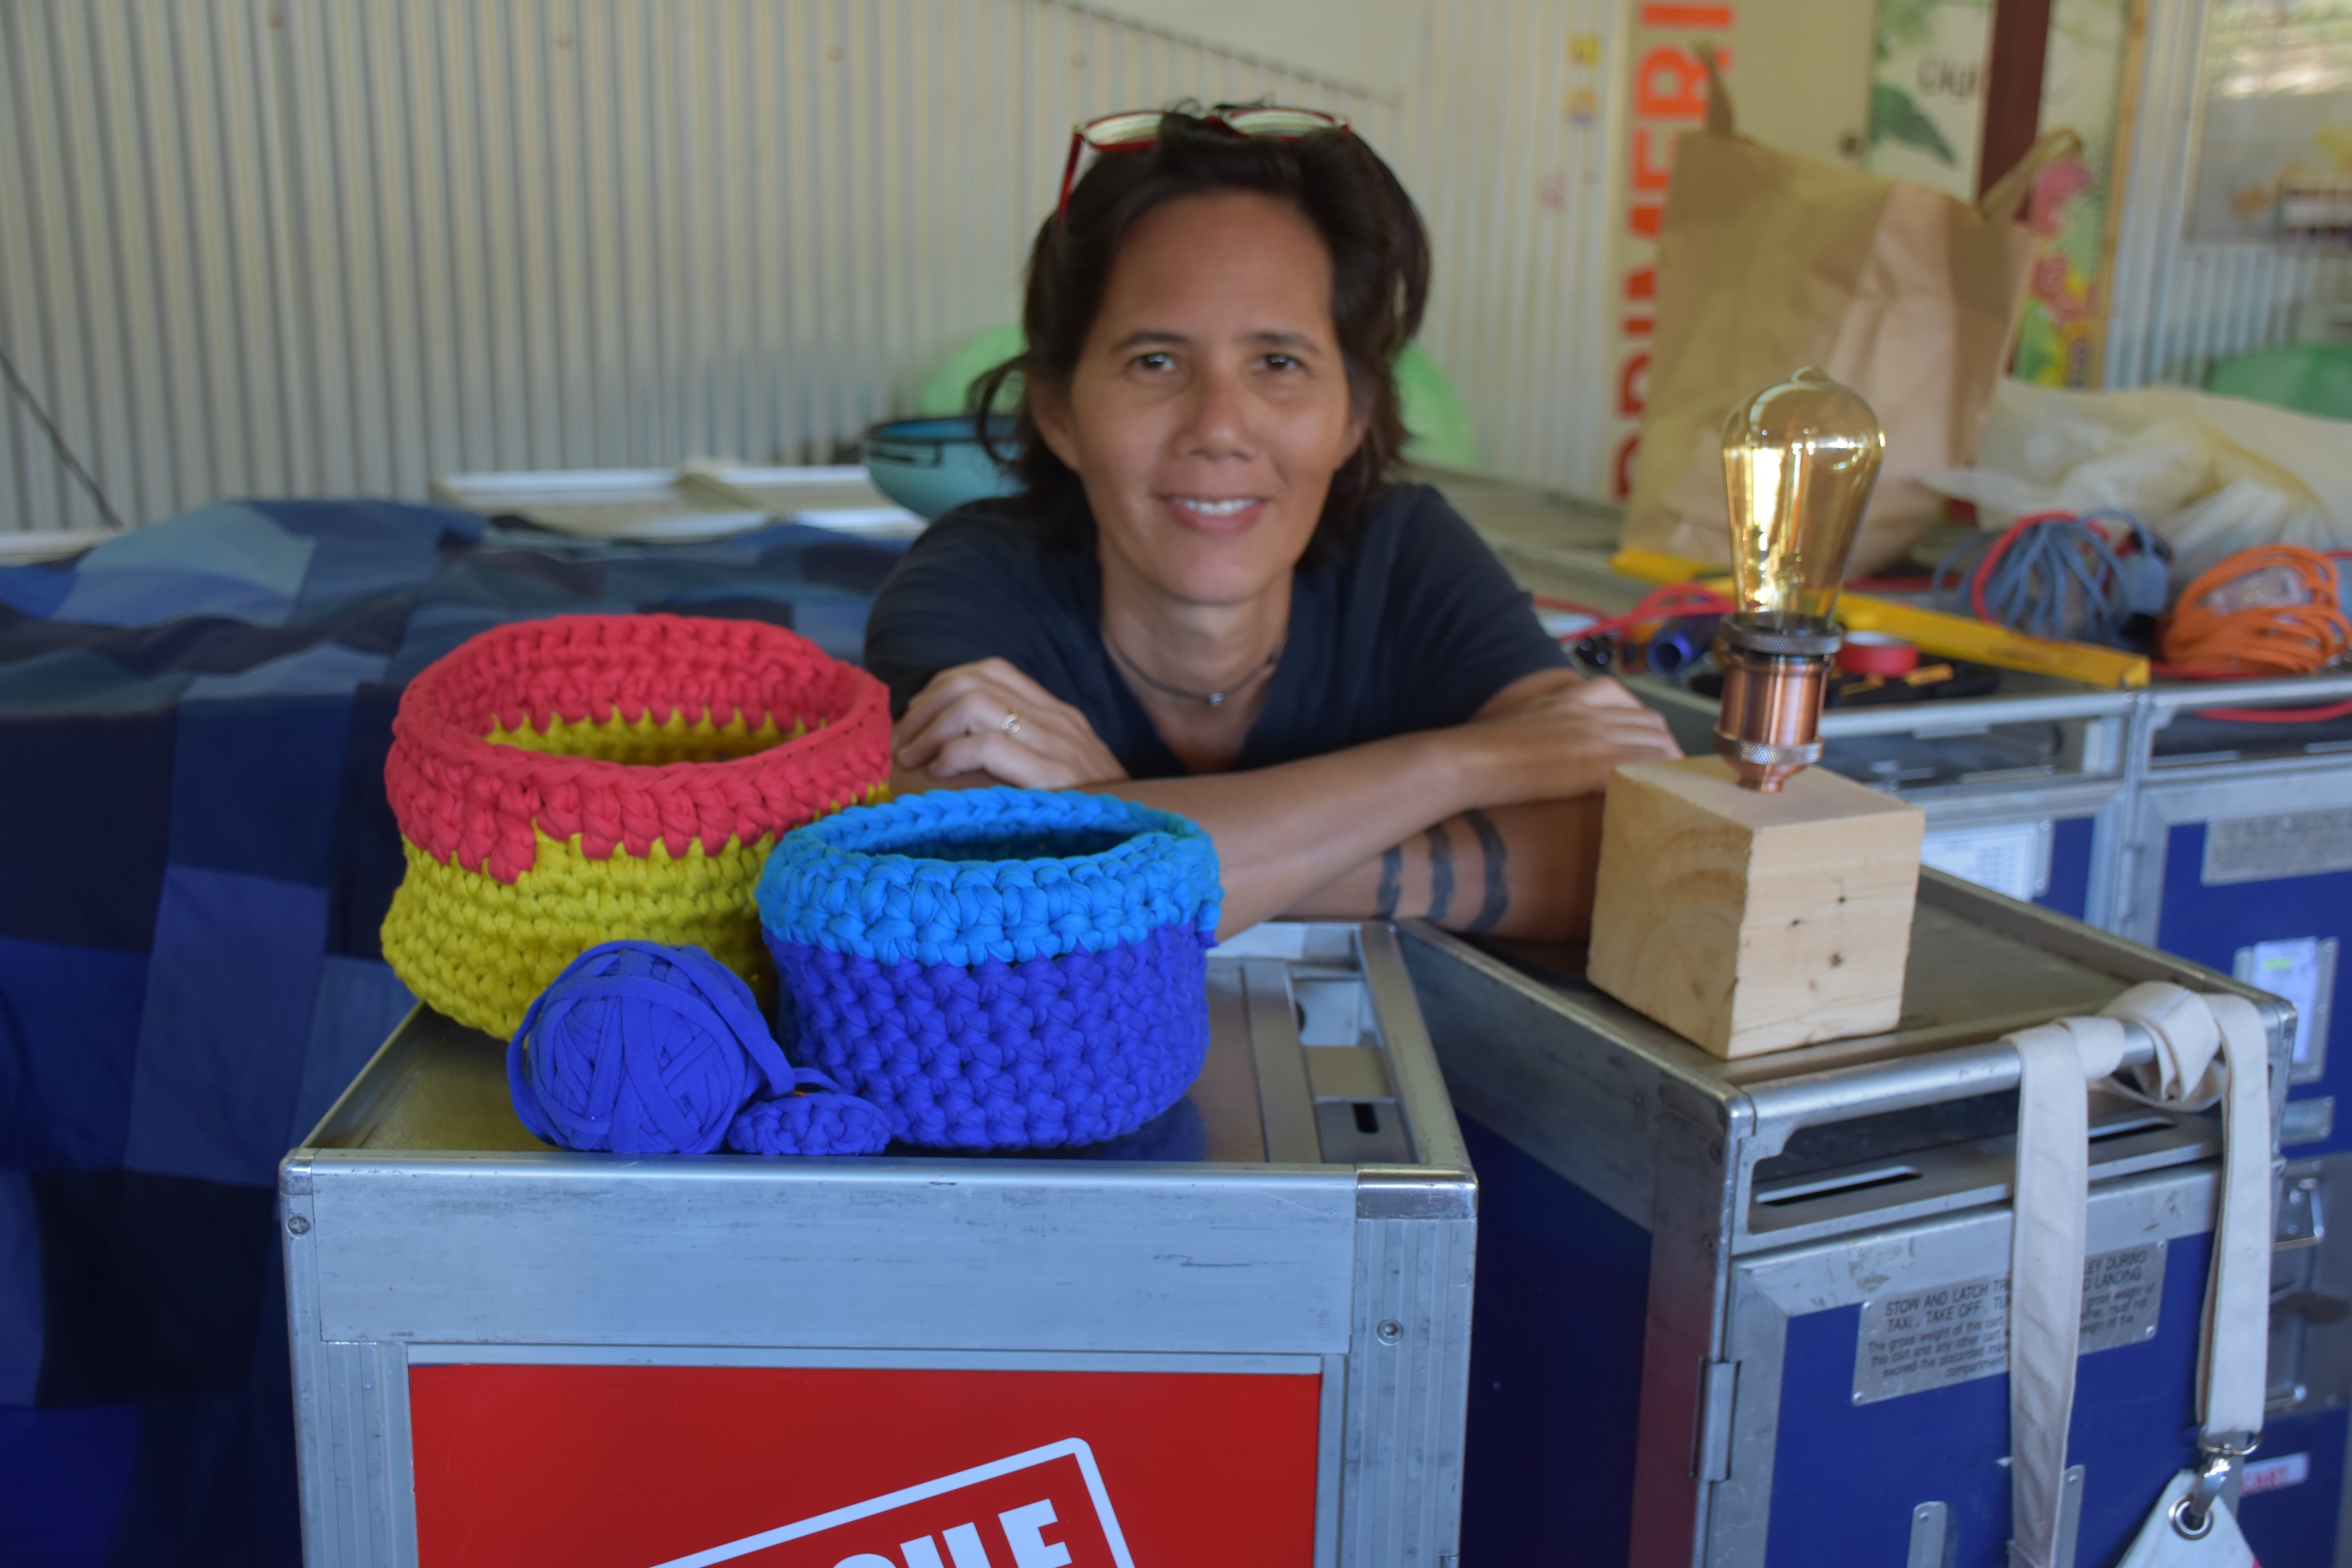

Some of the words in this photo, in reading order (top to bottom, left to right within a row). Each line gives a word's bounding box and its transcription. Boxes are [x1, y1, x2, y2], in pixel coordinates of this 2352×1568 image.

[1885, 1297, 1919, 1317] STOW
[1923, 1290, 1948, 1310] AND
[1952, 1283, 1988, 1303] LATCH
[1926, 1305, 1953, 1325] TAKE
